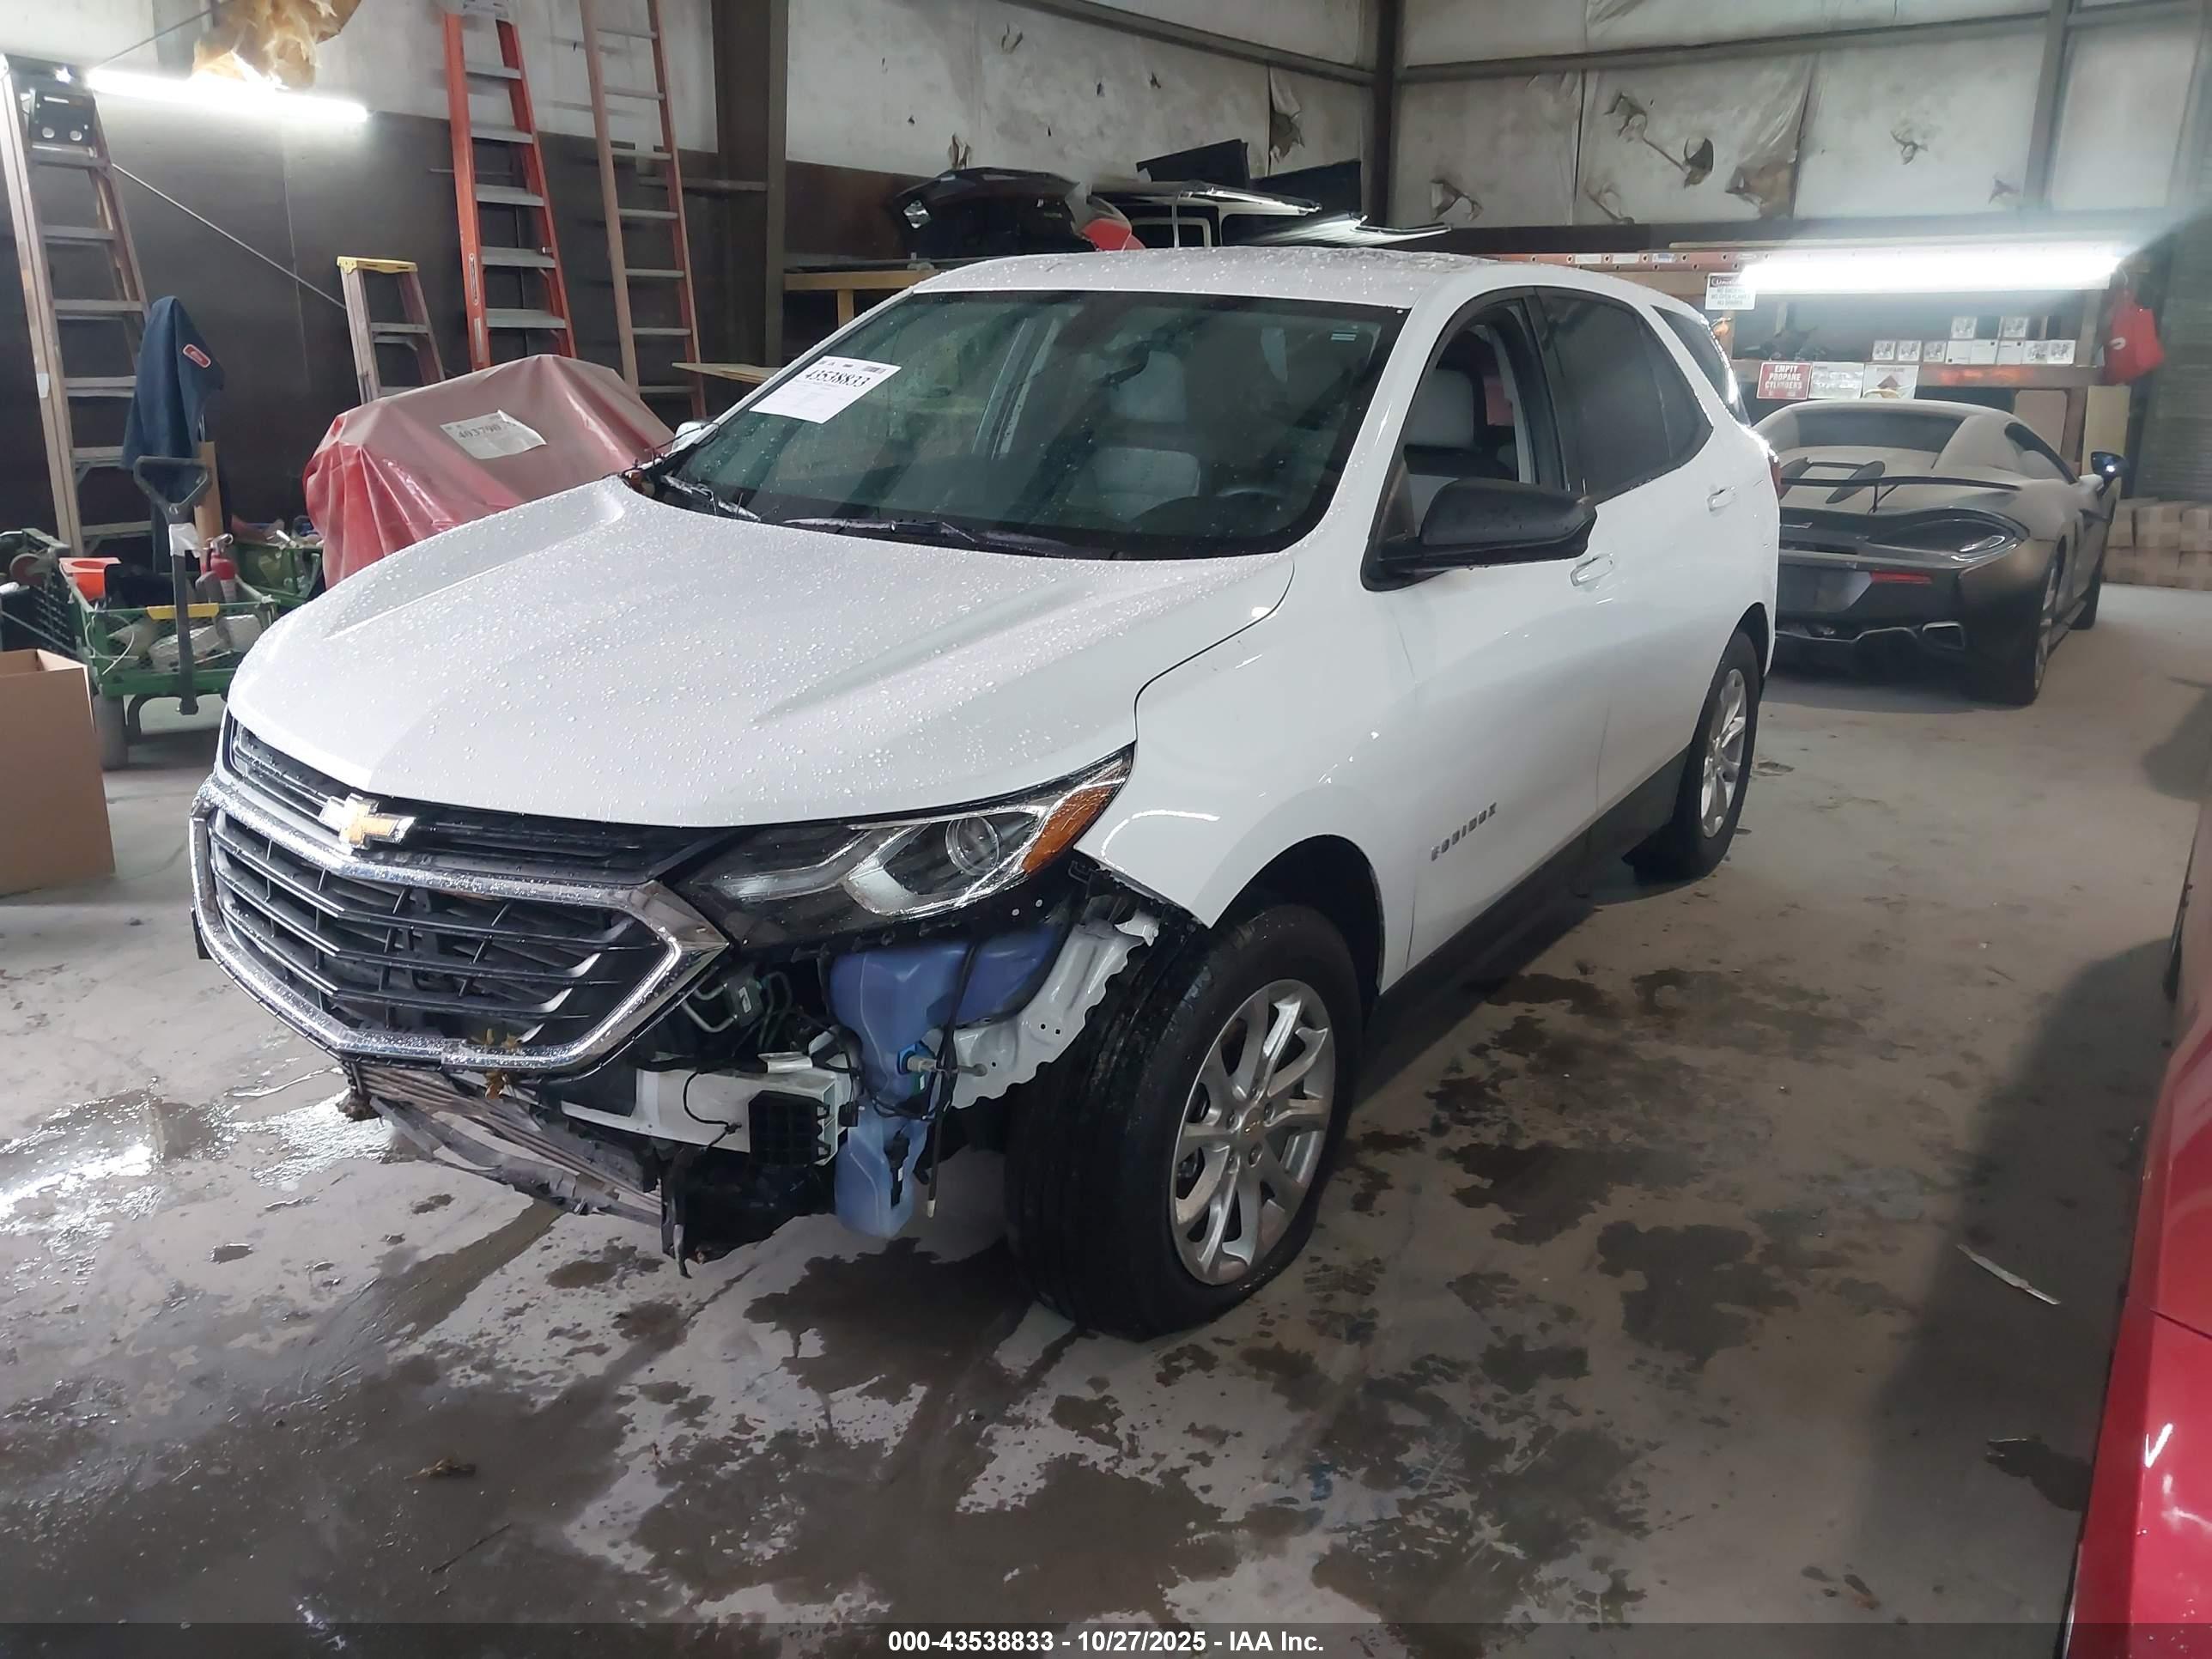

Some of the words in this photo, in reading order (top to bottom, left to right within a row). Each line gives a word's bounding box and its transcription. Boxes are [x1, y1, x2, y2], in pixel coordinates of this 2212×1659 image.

[805, 369, 871, 387] 43538833
[1769, 373, 1802, 381] PROPANE
[1431, 801, 1497, 862] EQUINOX
